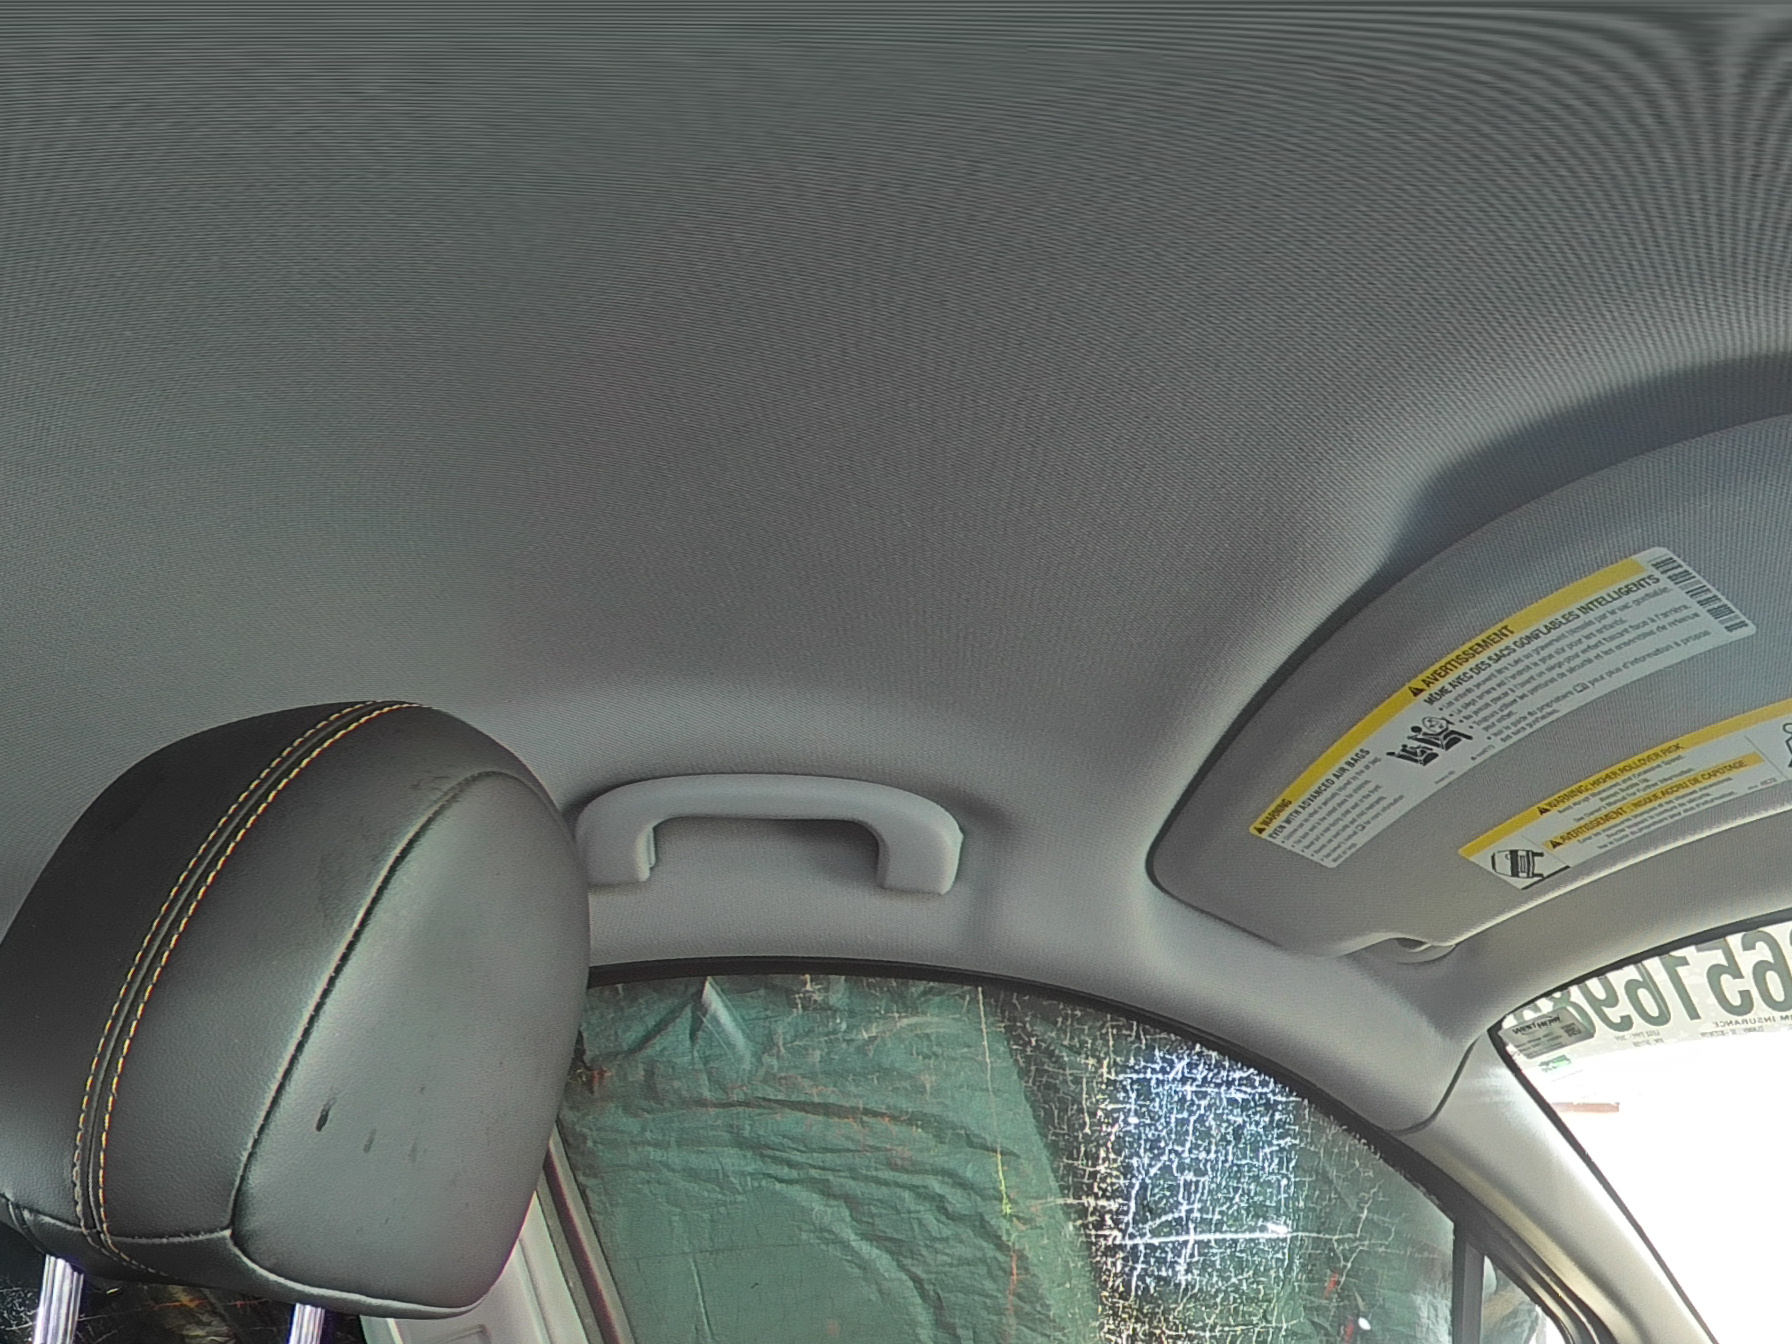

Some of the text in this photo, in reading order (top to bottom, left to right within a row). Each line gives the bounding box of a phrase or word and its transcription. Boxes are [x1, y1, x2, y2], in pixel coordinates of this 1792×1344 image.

[1421, 625, 1515, 688] AVERTISSEMENT
[1469, 660, 1492, 676] DES
[1487, 646, 1517, 664] SACS
[1577, 574, 1661, 615] INTELLIGENTS
[1268, 748, 1371, 840] EVEN WITH ADVANCED AIR BAGS
